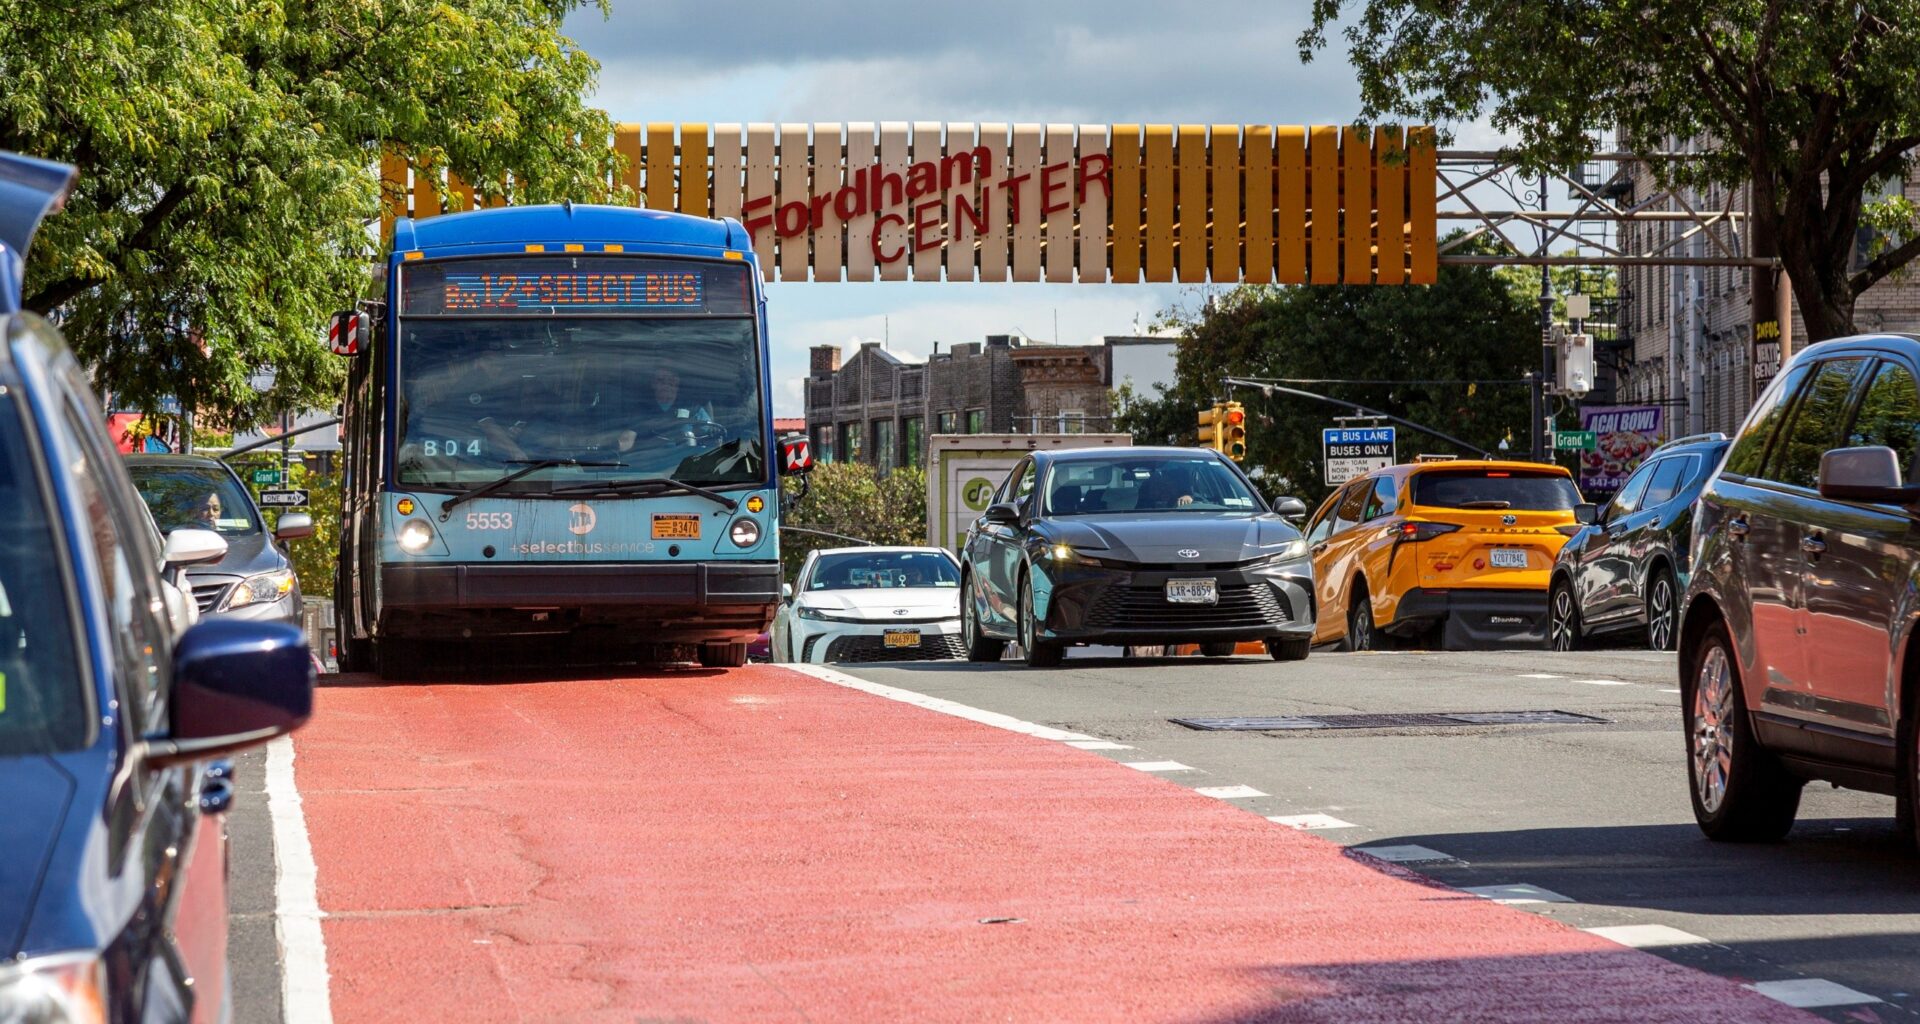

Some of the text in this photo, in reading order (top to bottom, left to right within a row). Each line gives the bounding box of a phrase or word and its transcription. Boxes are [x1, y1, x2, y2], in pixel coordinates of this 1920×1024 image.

[741, 145, 993, 247] Fordham
[871, 153, 1113, 264] CENTER
[646, 273, 697, 303] BUS
[1589, 411, 1656, 434] ACAI BOWL
[1342, 430, 1389, 441] BUS LANE
[1557, 433, 1583, 447] Grand
[424, 438, 481, 457] 804
[1330, 445, 1389, 456] BUSES ONLY
[255, 471, 273, 482] Grand
[466, 512, 513, 530] 5553
